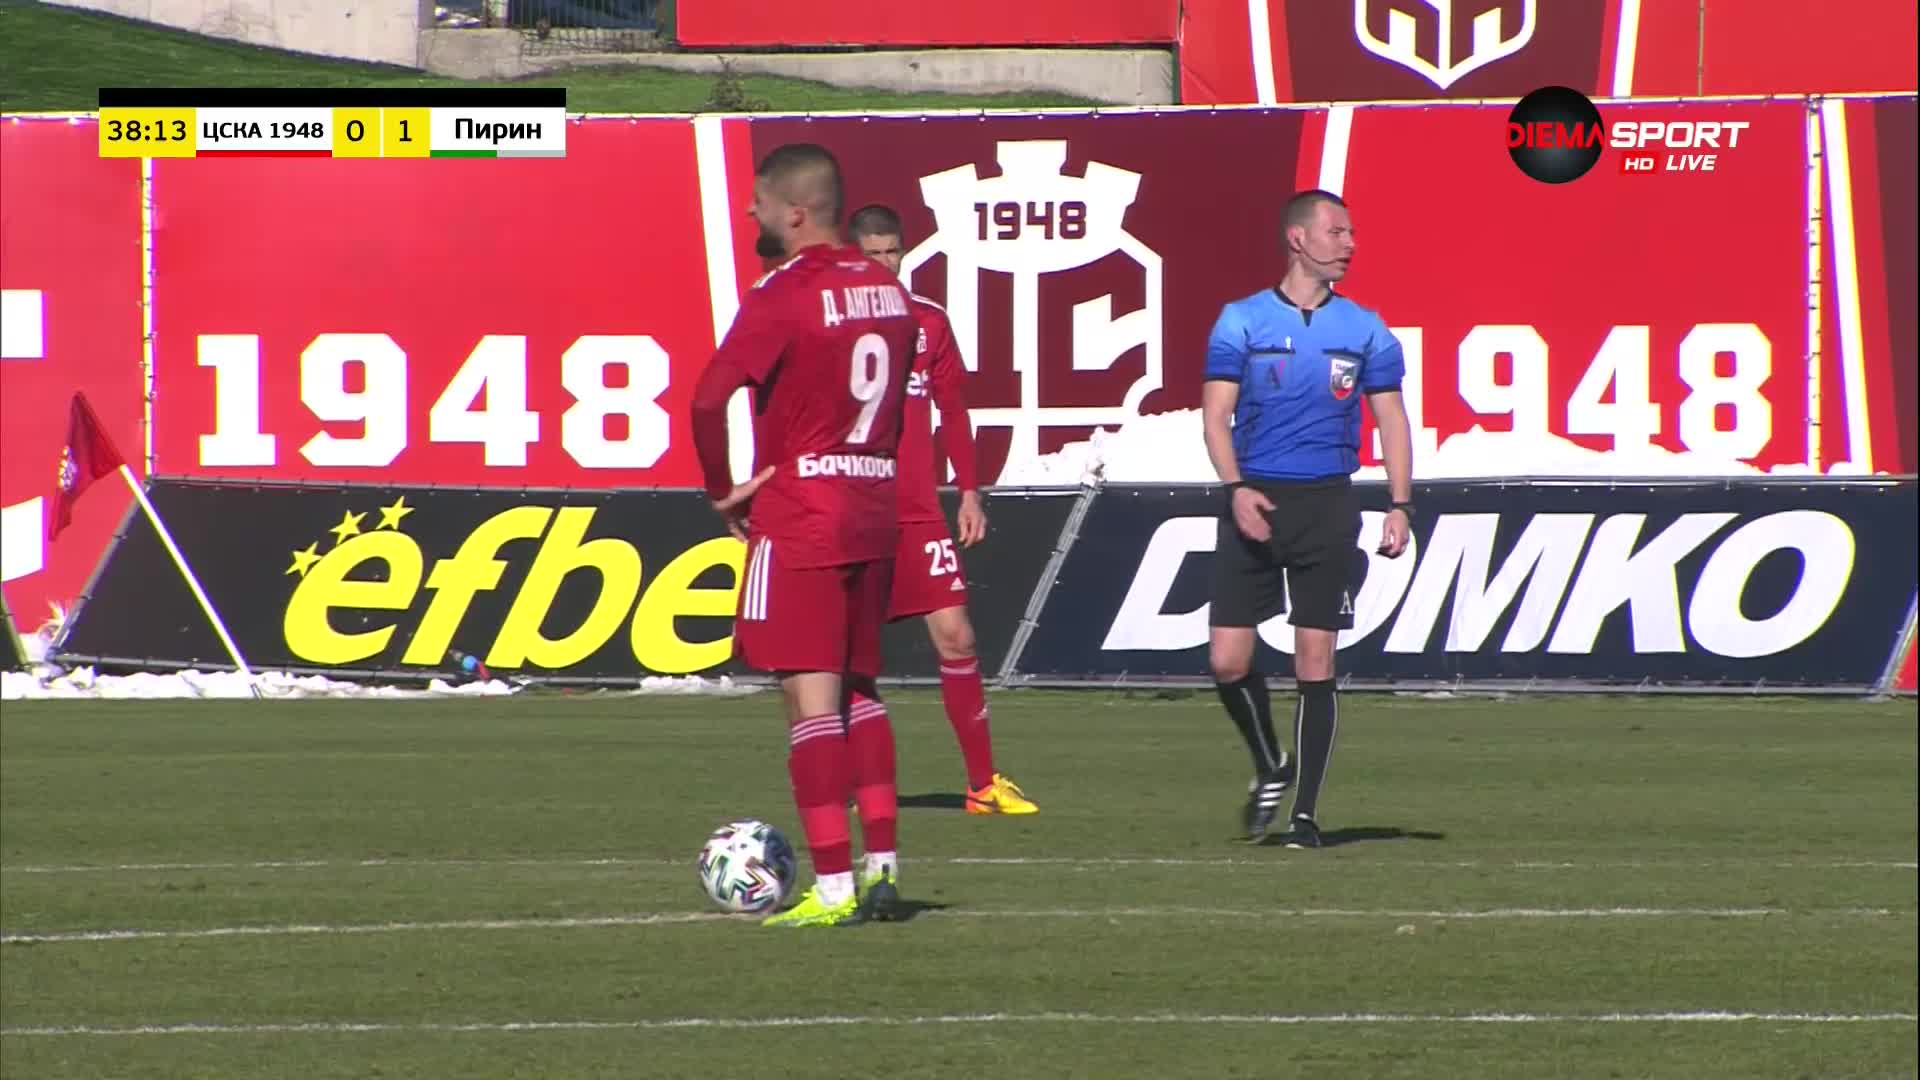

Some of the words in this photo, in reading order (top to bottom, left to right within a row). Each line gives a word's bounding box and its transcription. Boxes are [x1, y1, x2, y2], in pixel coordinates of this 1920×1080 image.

[974, 201, 1087, 240] 1948
[197, 333, 671, 469] 1948
[846, 333, 890, 444] 9
[283, 506, 742, 673] efbe
[925, 538, 958, 576] 25
